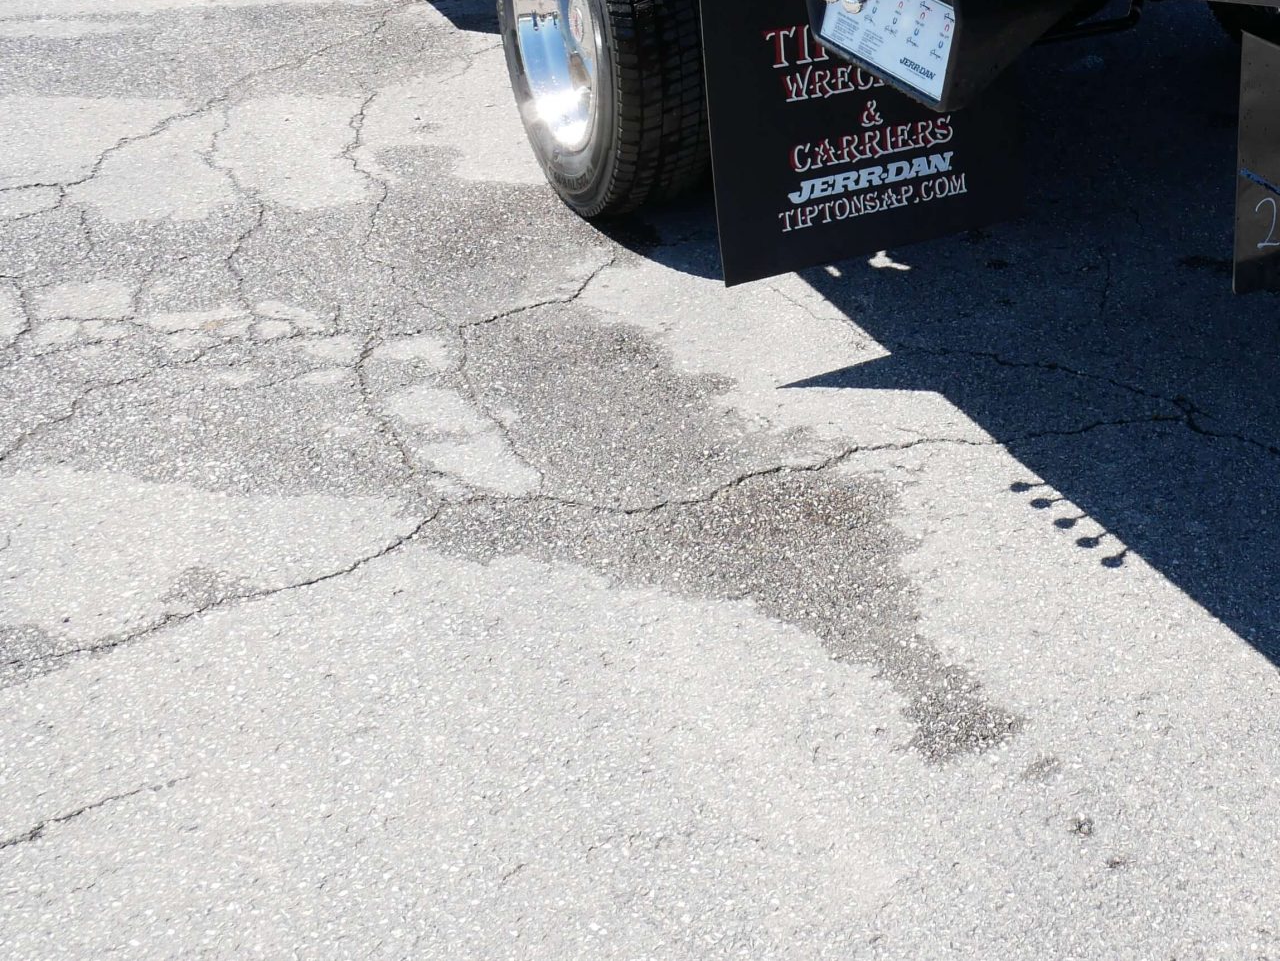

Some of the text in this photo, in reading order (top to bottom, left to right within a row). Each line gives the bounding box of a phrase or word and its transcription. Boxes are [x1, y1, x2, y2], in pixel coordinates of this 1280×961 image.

[860, 99, 884, 127] &
[789, 114, 954, 173] CARRIERS
[778, 172, 968, 233] TIPTONSAP.COM
